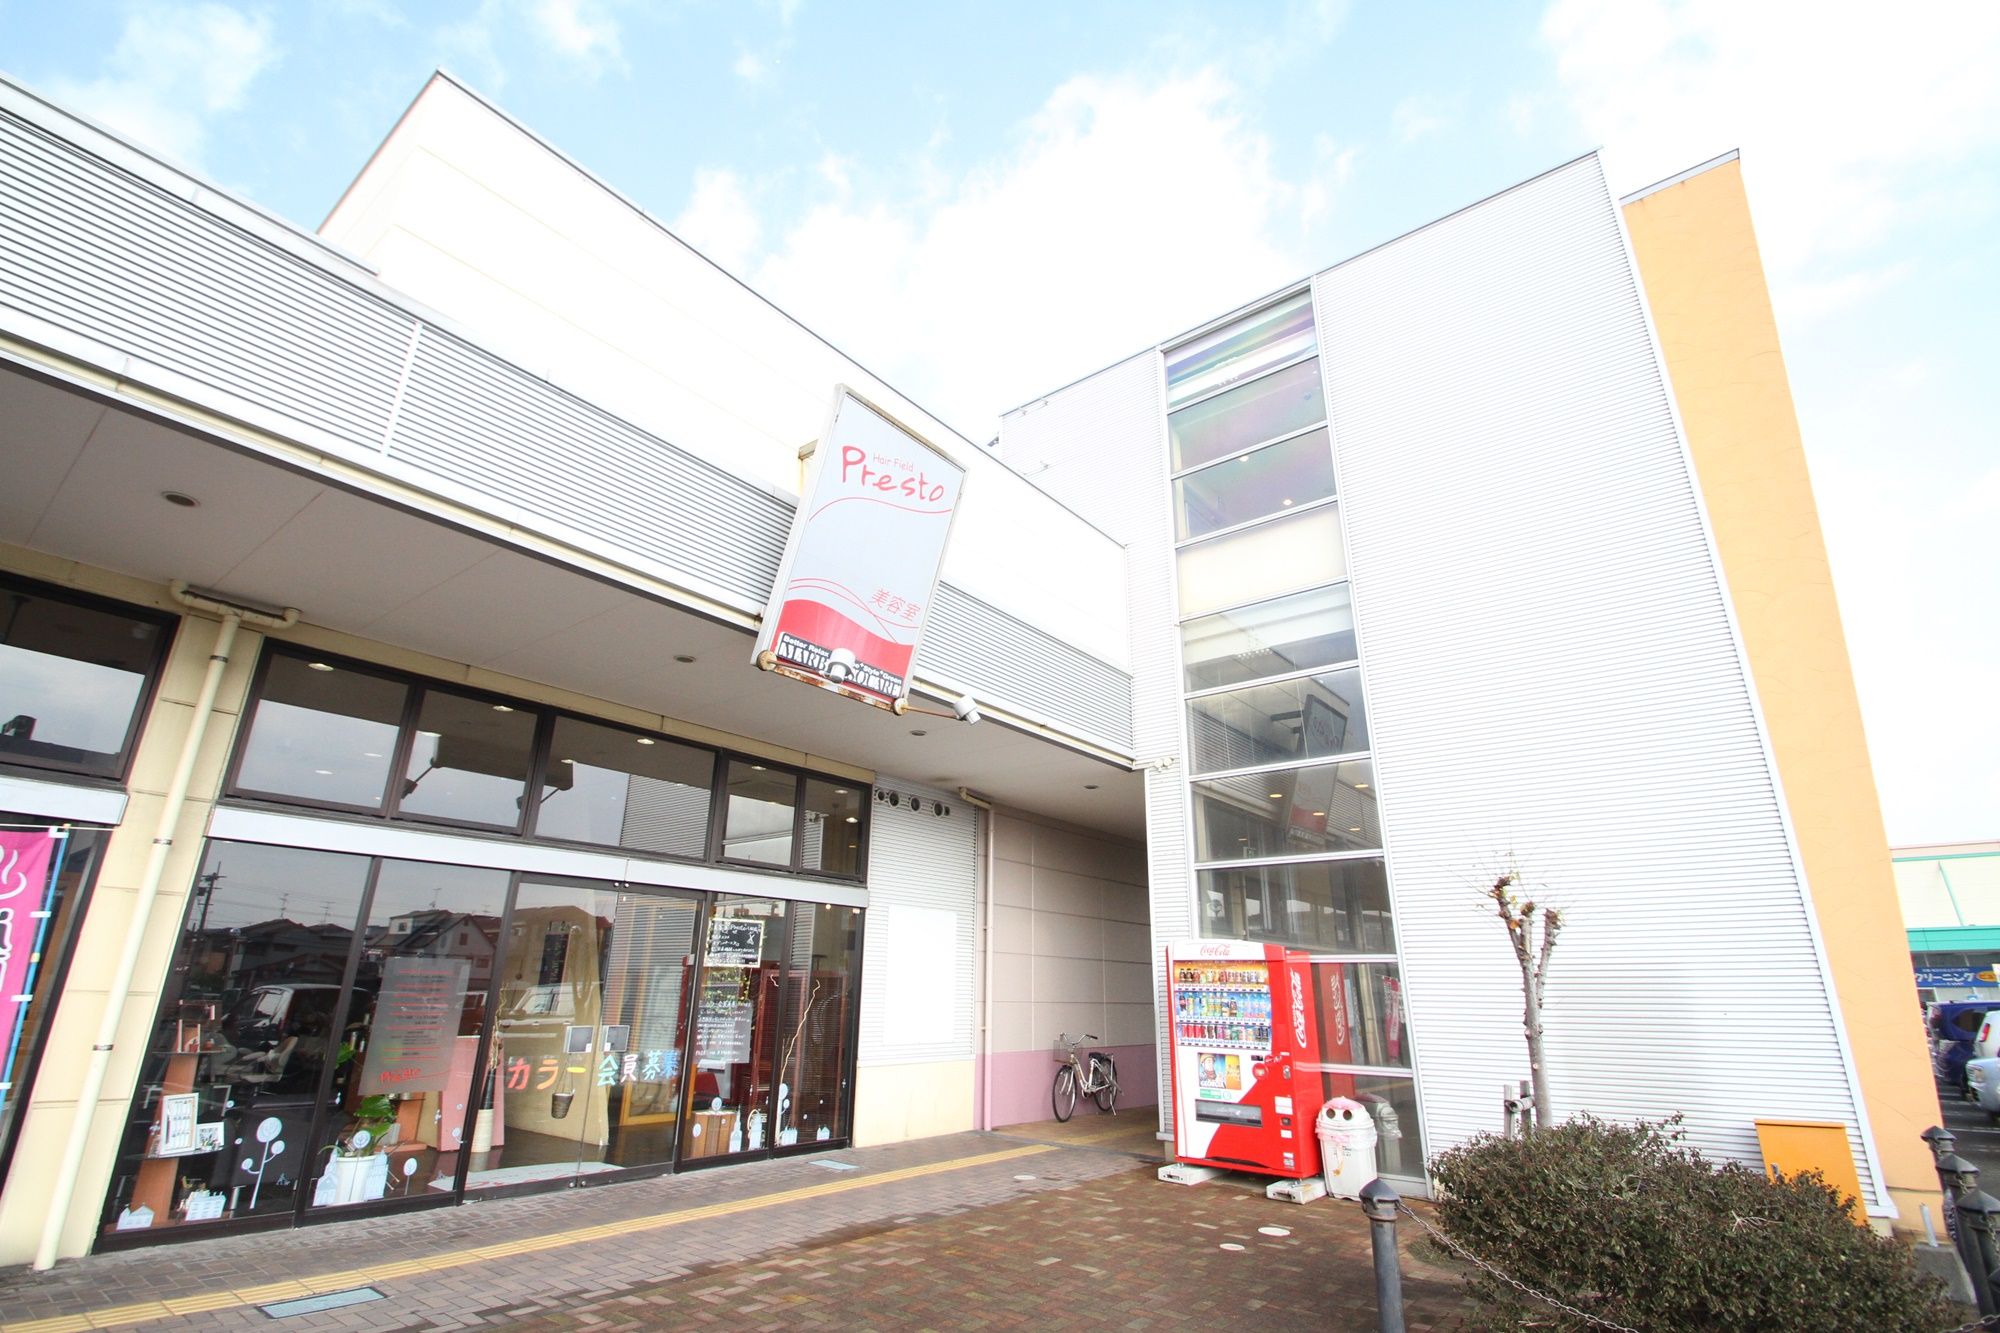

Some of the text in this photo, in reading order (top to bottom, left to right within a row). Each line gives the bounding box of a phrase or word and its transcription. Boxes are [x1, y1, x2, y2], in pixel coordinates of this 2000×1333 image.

[842, 445, 945, 502] Presto
[873, 453, 914, 472] Hair Field
[869, 588, 921, 621] 美容室
[779, 642, 829, 670] MARB
